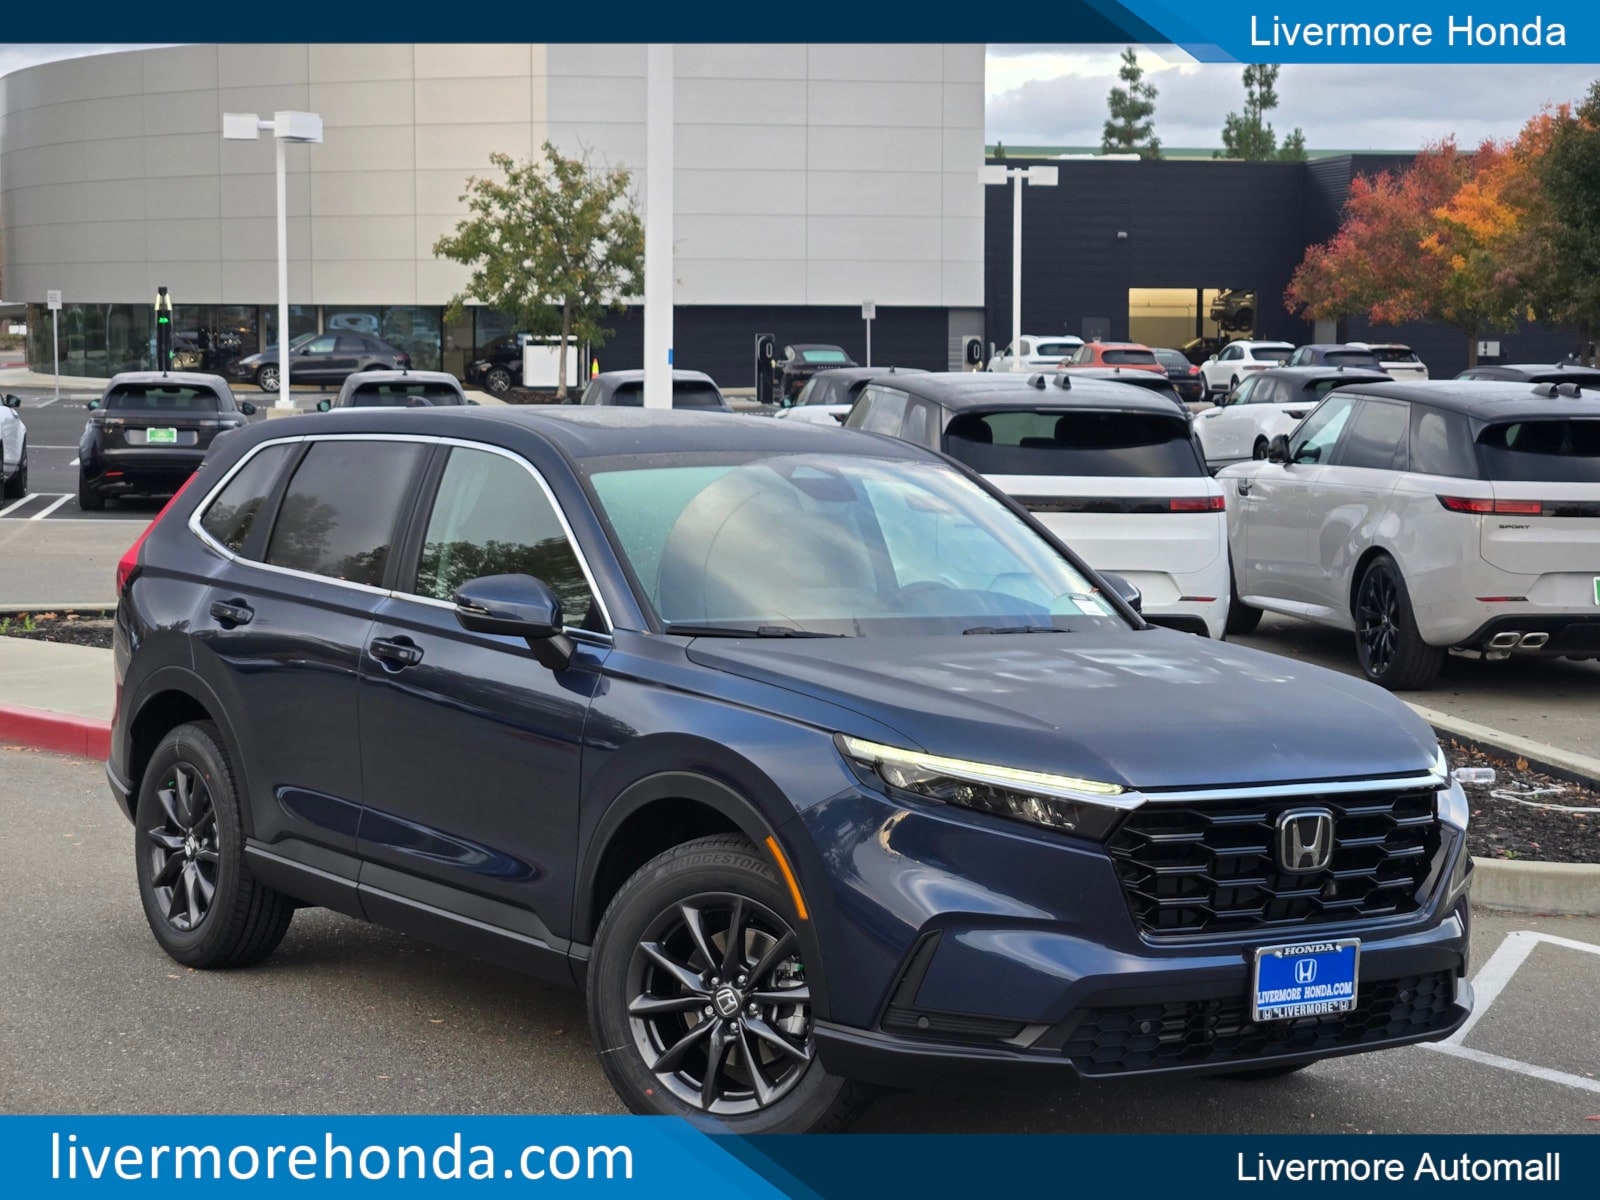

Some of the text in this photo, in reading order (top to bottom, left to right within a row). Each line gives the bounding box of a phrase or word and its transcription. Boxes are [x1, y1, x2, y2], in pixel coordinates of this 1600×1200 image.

[665, 853, 771, 875] BRIDGESTONE
[1283, 943, 1335, 956] HONDA
[1257, 981, 1353, 1004] LIVERMORE HONDA.COM
[1278, 1002, 1334, 1018] LIVERMORE
